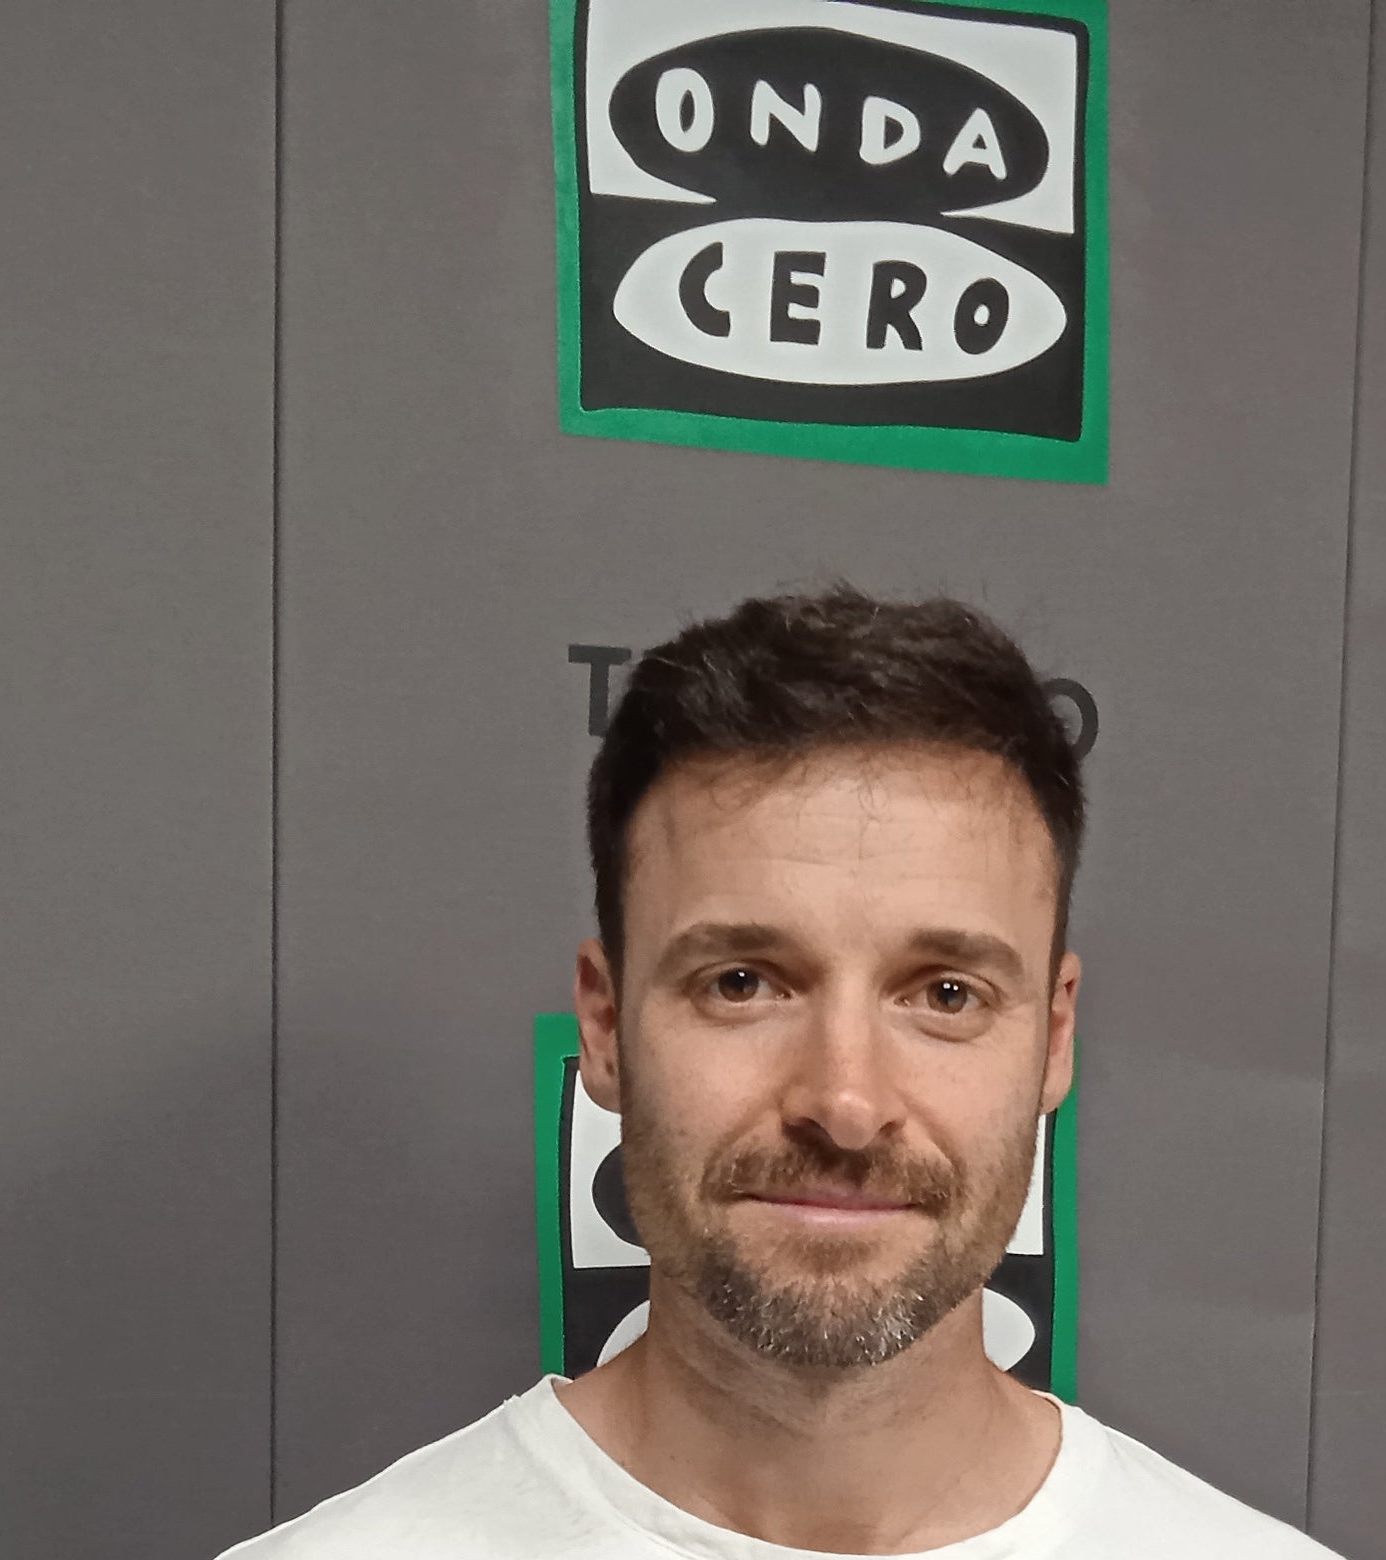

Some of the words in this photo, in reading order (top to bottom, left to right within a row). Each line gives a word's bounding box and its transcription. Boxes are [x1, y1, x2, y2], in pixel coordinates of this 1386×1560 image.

[655, 67, 1007, 180] ONDA
[678, 241, 1010, 356] CERO
[567, 643, 656, 738] T
